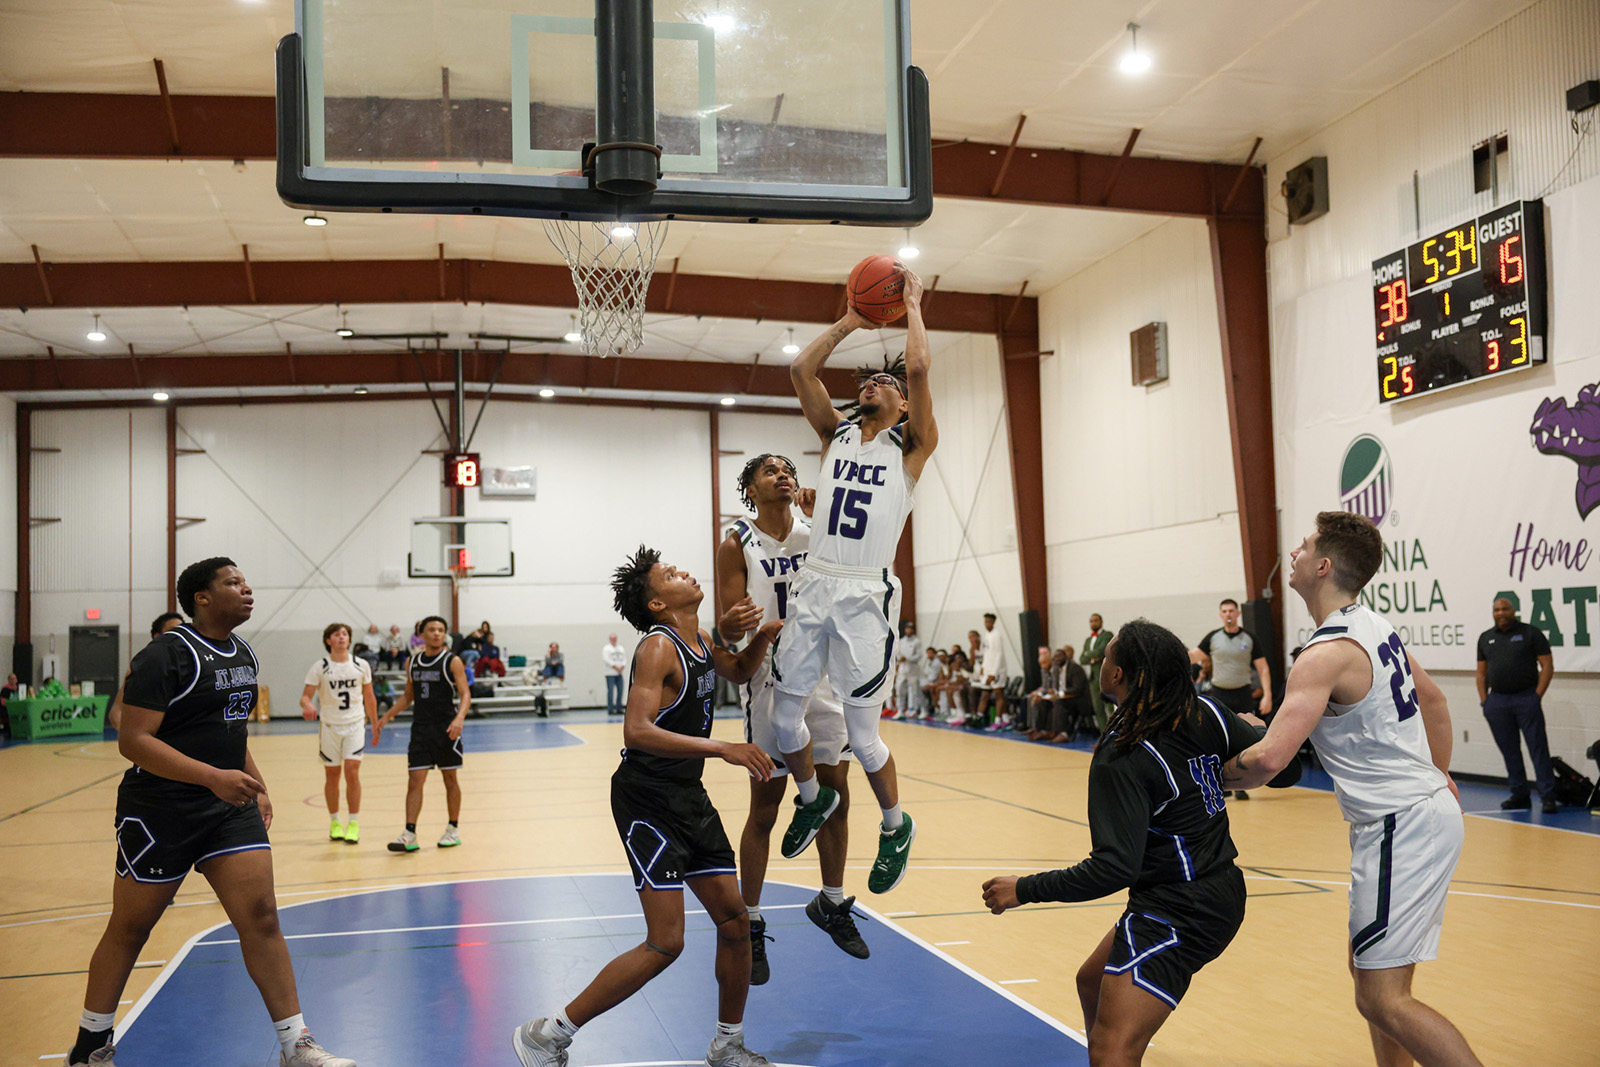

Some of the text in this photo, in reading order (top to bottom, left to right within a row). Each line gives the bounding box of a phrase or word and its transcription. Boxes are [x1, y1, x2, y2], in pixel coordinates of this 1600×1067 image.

[1479, 211, 1521, 244] GUEST
[1423, 226, 1476, 284] 5:34
[1499, 235, 1523, 284] 15
[1372, 260, 1403, 286] HOME
[1378, 279, 1408, 327] 38
[1470, 294, 1495, 312] BONUS
[1500, 300, 1528, 319] FOULS
[1401, 319, 1421, 334] BONUS
[1431, 323, 1460, 340] PLAYER
[1509, 317, 1527, 365] 3
[1487, 341, 1500, 371] 3
[1383, 356, 1398, 399] 2
[1401, 365, 1414, 394] 5
[457, 461, 477, 486] 18
[833, 458, 887, 487] VPCC
[827, 487, 873, 540] 15
[1377, 538, 1428, 573] NIA
[1509, 523, 1593, 582] Home
[1360, 579, 1447, 616] NSULA
[1394, 625, 1465, 645] OLLEGE
[329, 678, 357, 690] VPCC
[41, 702, 98, 722] cricket
[224, 691, 252, 720] 23
[338, 691, 350, 711] 3
